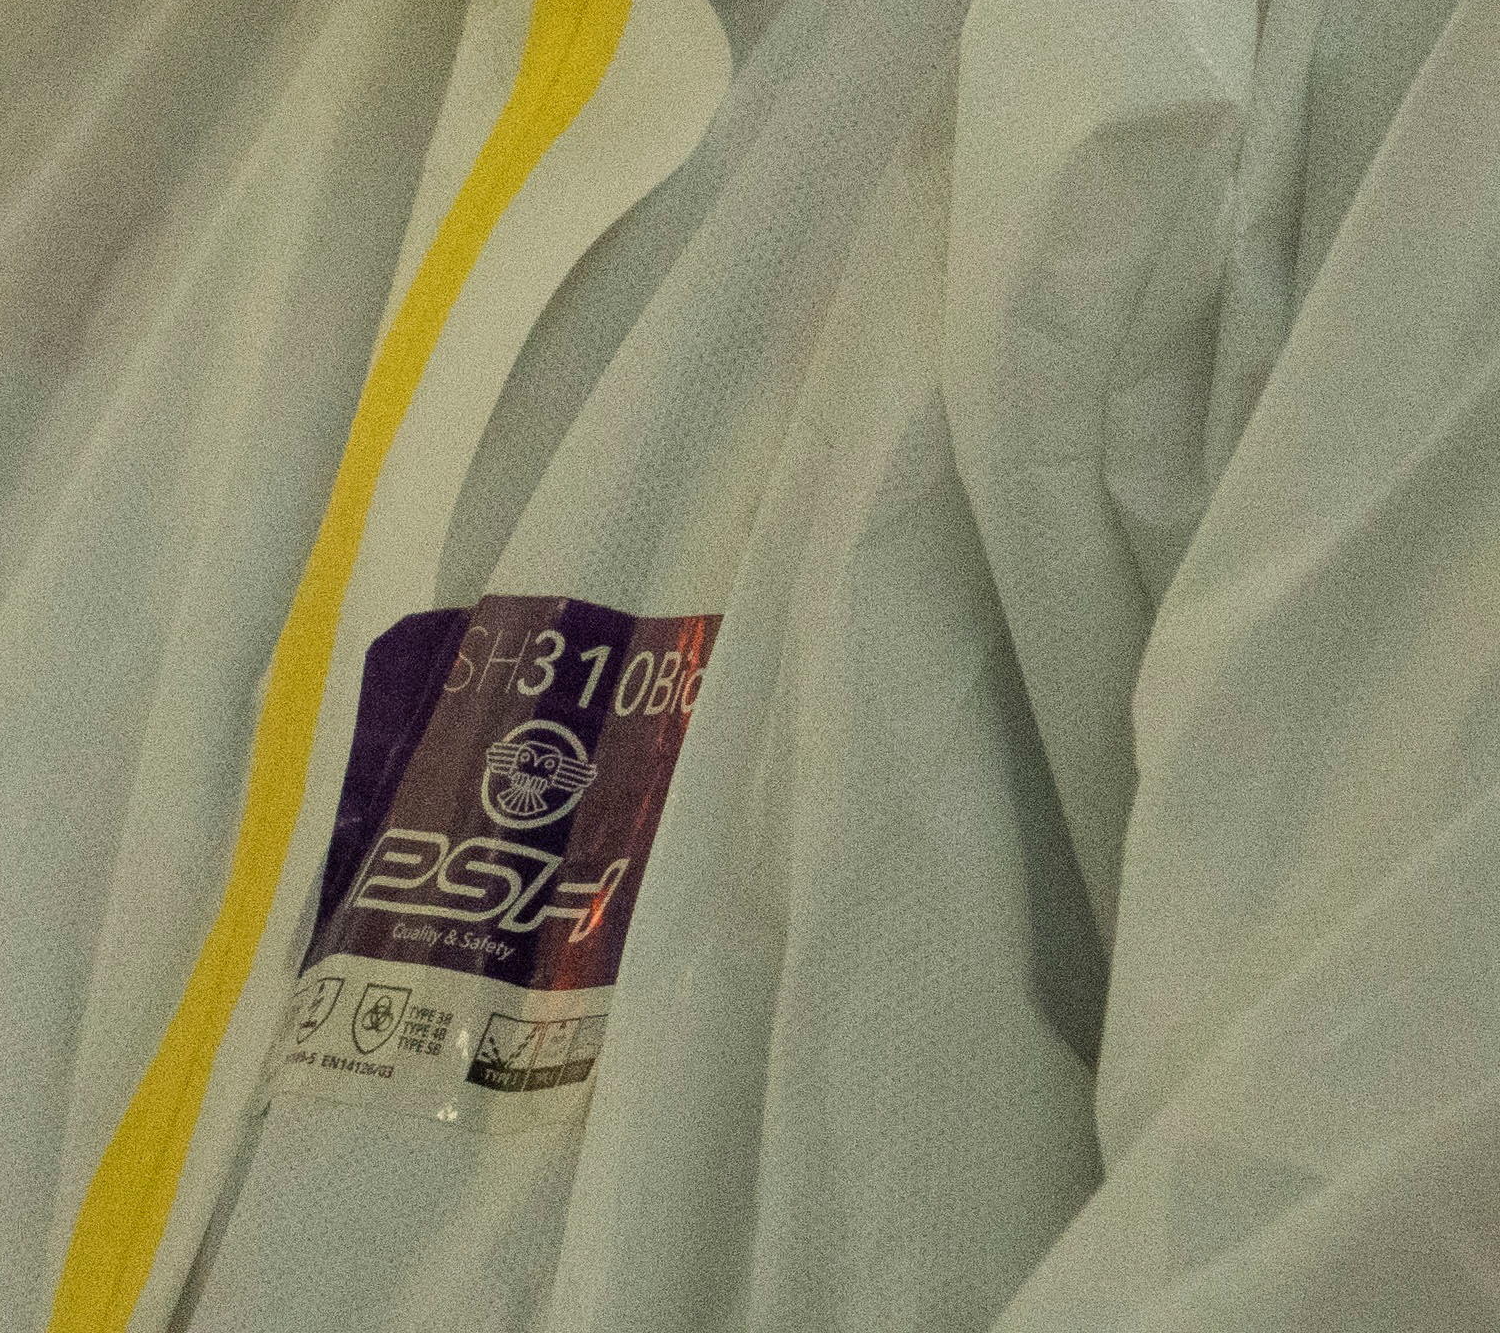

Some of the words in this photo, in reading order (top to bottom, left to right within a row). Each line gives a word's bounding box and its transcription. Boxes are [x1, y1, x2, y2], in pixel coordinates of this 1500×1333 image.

[344, 828, 631, 943] PSH
[392, 922, 444, 947] Quality
[444, 929, 459, 946] &
[459, 932, 516, 961] Safety
[408, 1005, 437, 1023] TYPE
[403, 1020, 431, 1038] TYPE
[397, 1035, 425, 1054] TYPE
